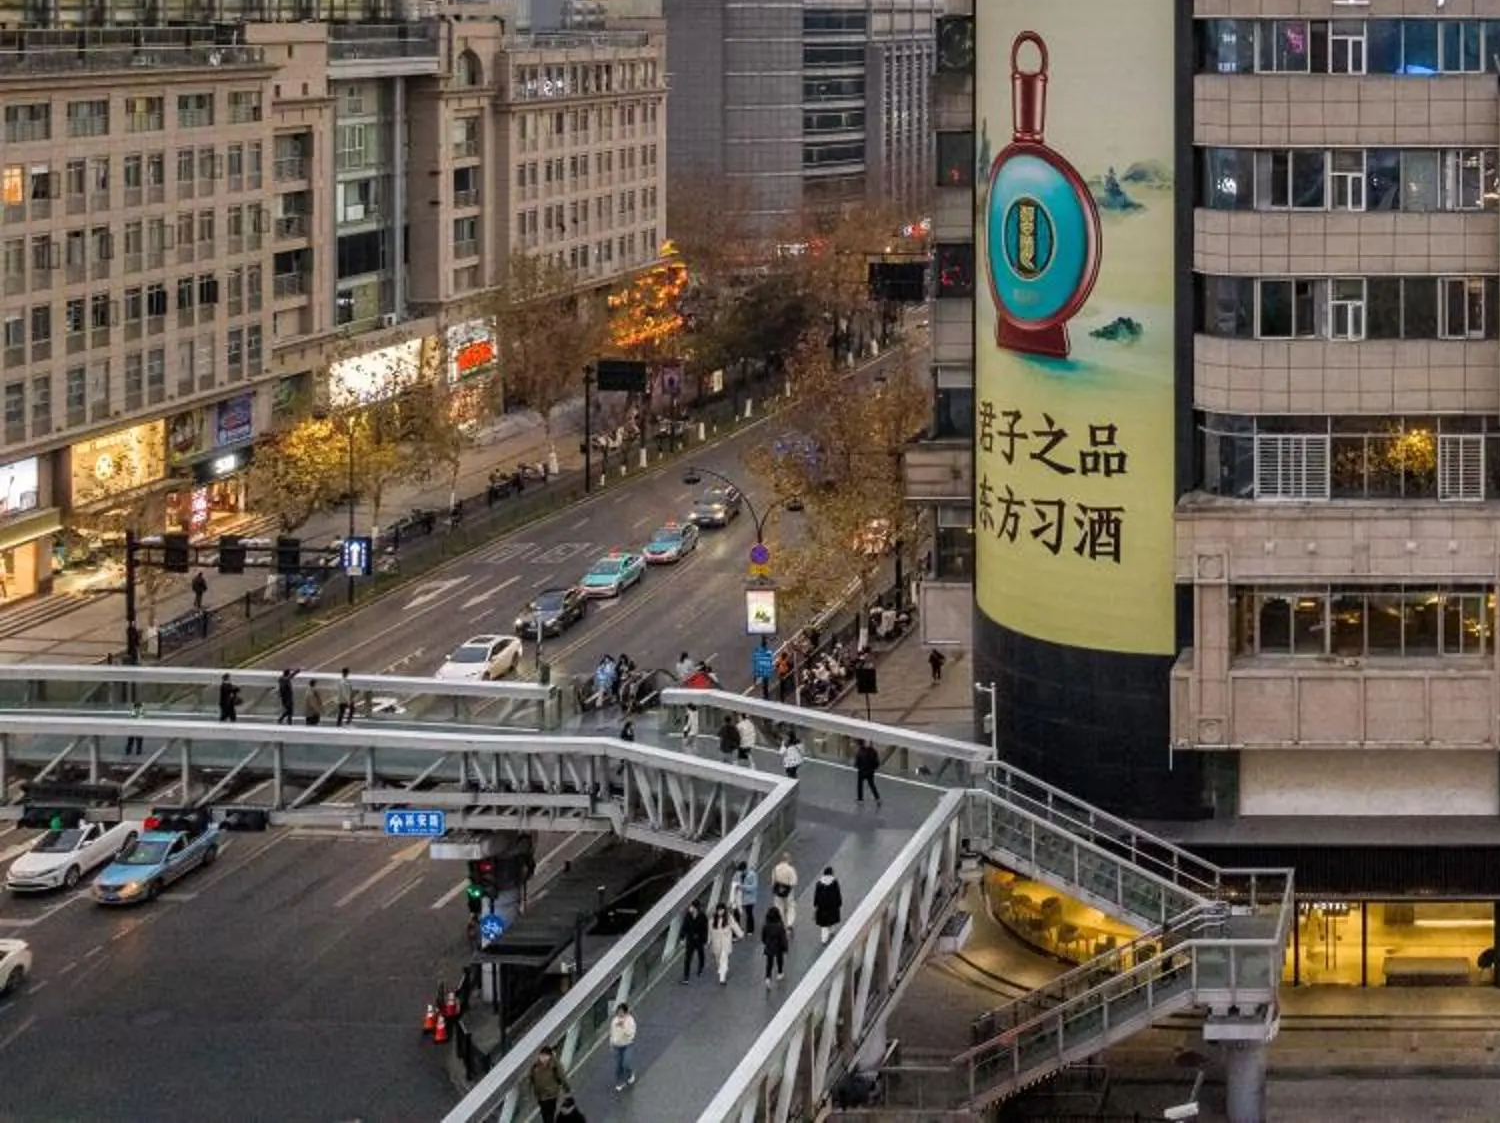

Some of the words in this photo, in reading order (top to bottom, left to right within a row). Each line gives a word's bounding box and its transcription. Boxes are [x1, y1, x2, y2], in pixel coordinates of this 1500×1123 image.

[979, 400, 1128, 478] 君子之品
[979, 472, 1127, 564] 东方习酒
